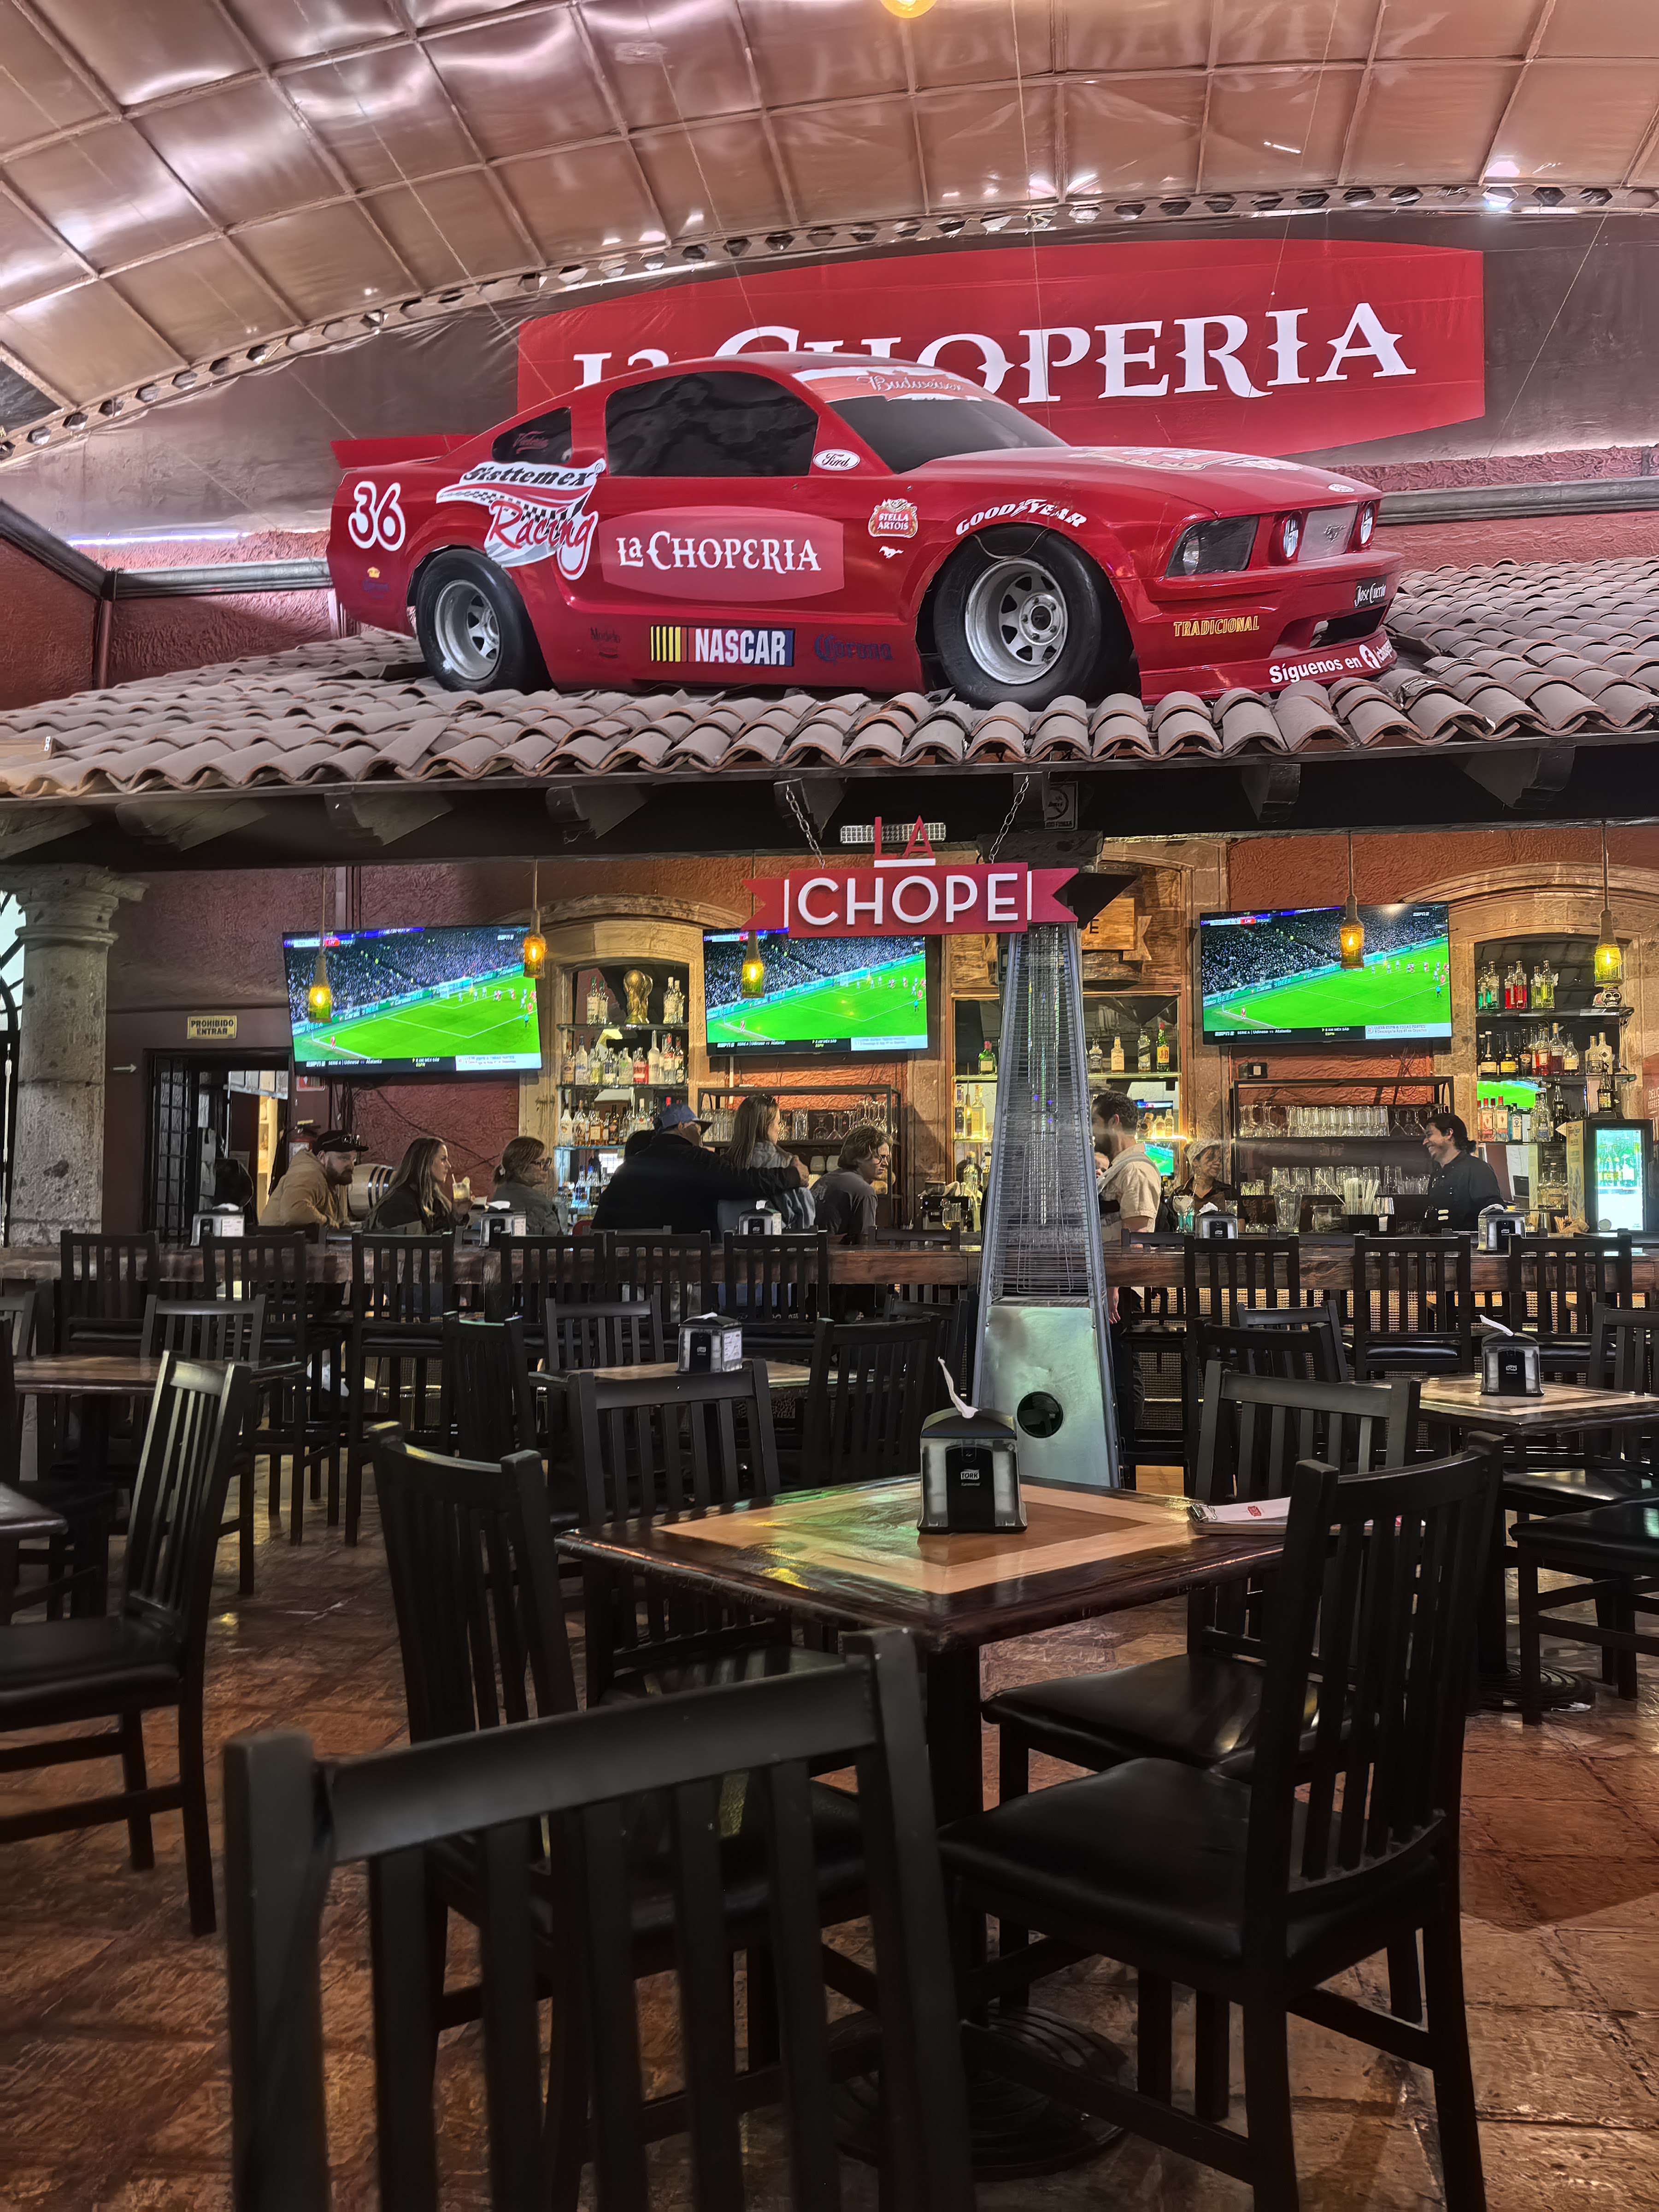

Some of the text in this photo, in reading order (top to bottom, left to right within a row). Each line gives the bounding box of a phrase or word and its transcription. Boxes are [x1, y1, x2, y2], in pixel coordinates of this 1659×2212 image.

[713, 301, 1416, 404] OPERIA
[821, 452, 850, 469] Ford
[348, 481, 406, 551] 36
[877, 521, 909, 530] ARTOIS
[878, 513, 909, 522] STELLA
[488, 500, 598, 580] Racing
[616, 530, 822, 574] La CHOPERIA
[1173, 616, 1260, 637] TRADICIONAL
[695, 628, 786, 665] NASCAR
[814, 634, 894, 666] Corona
[1269, 659, 1343, 683] Síguenos
[1344, 657, 1363, 669] en
[875, 815, 935, 859] LA
[797, 874, 1018, 926] CHOPE
[1217, 993, 1235, 1004] BEER
[191, 1019, 234, 1028] PROHIBIDO
[197, 1027, 228, 1035] ENTRAR
